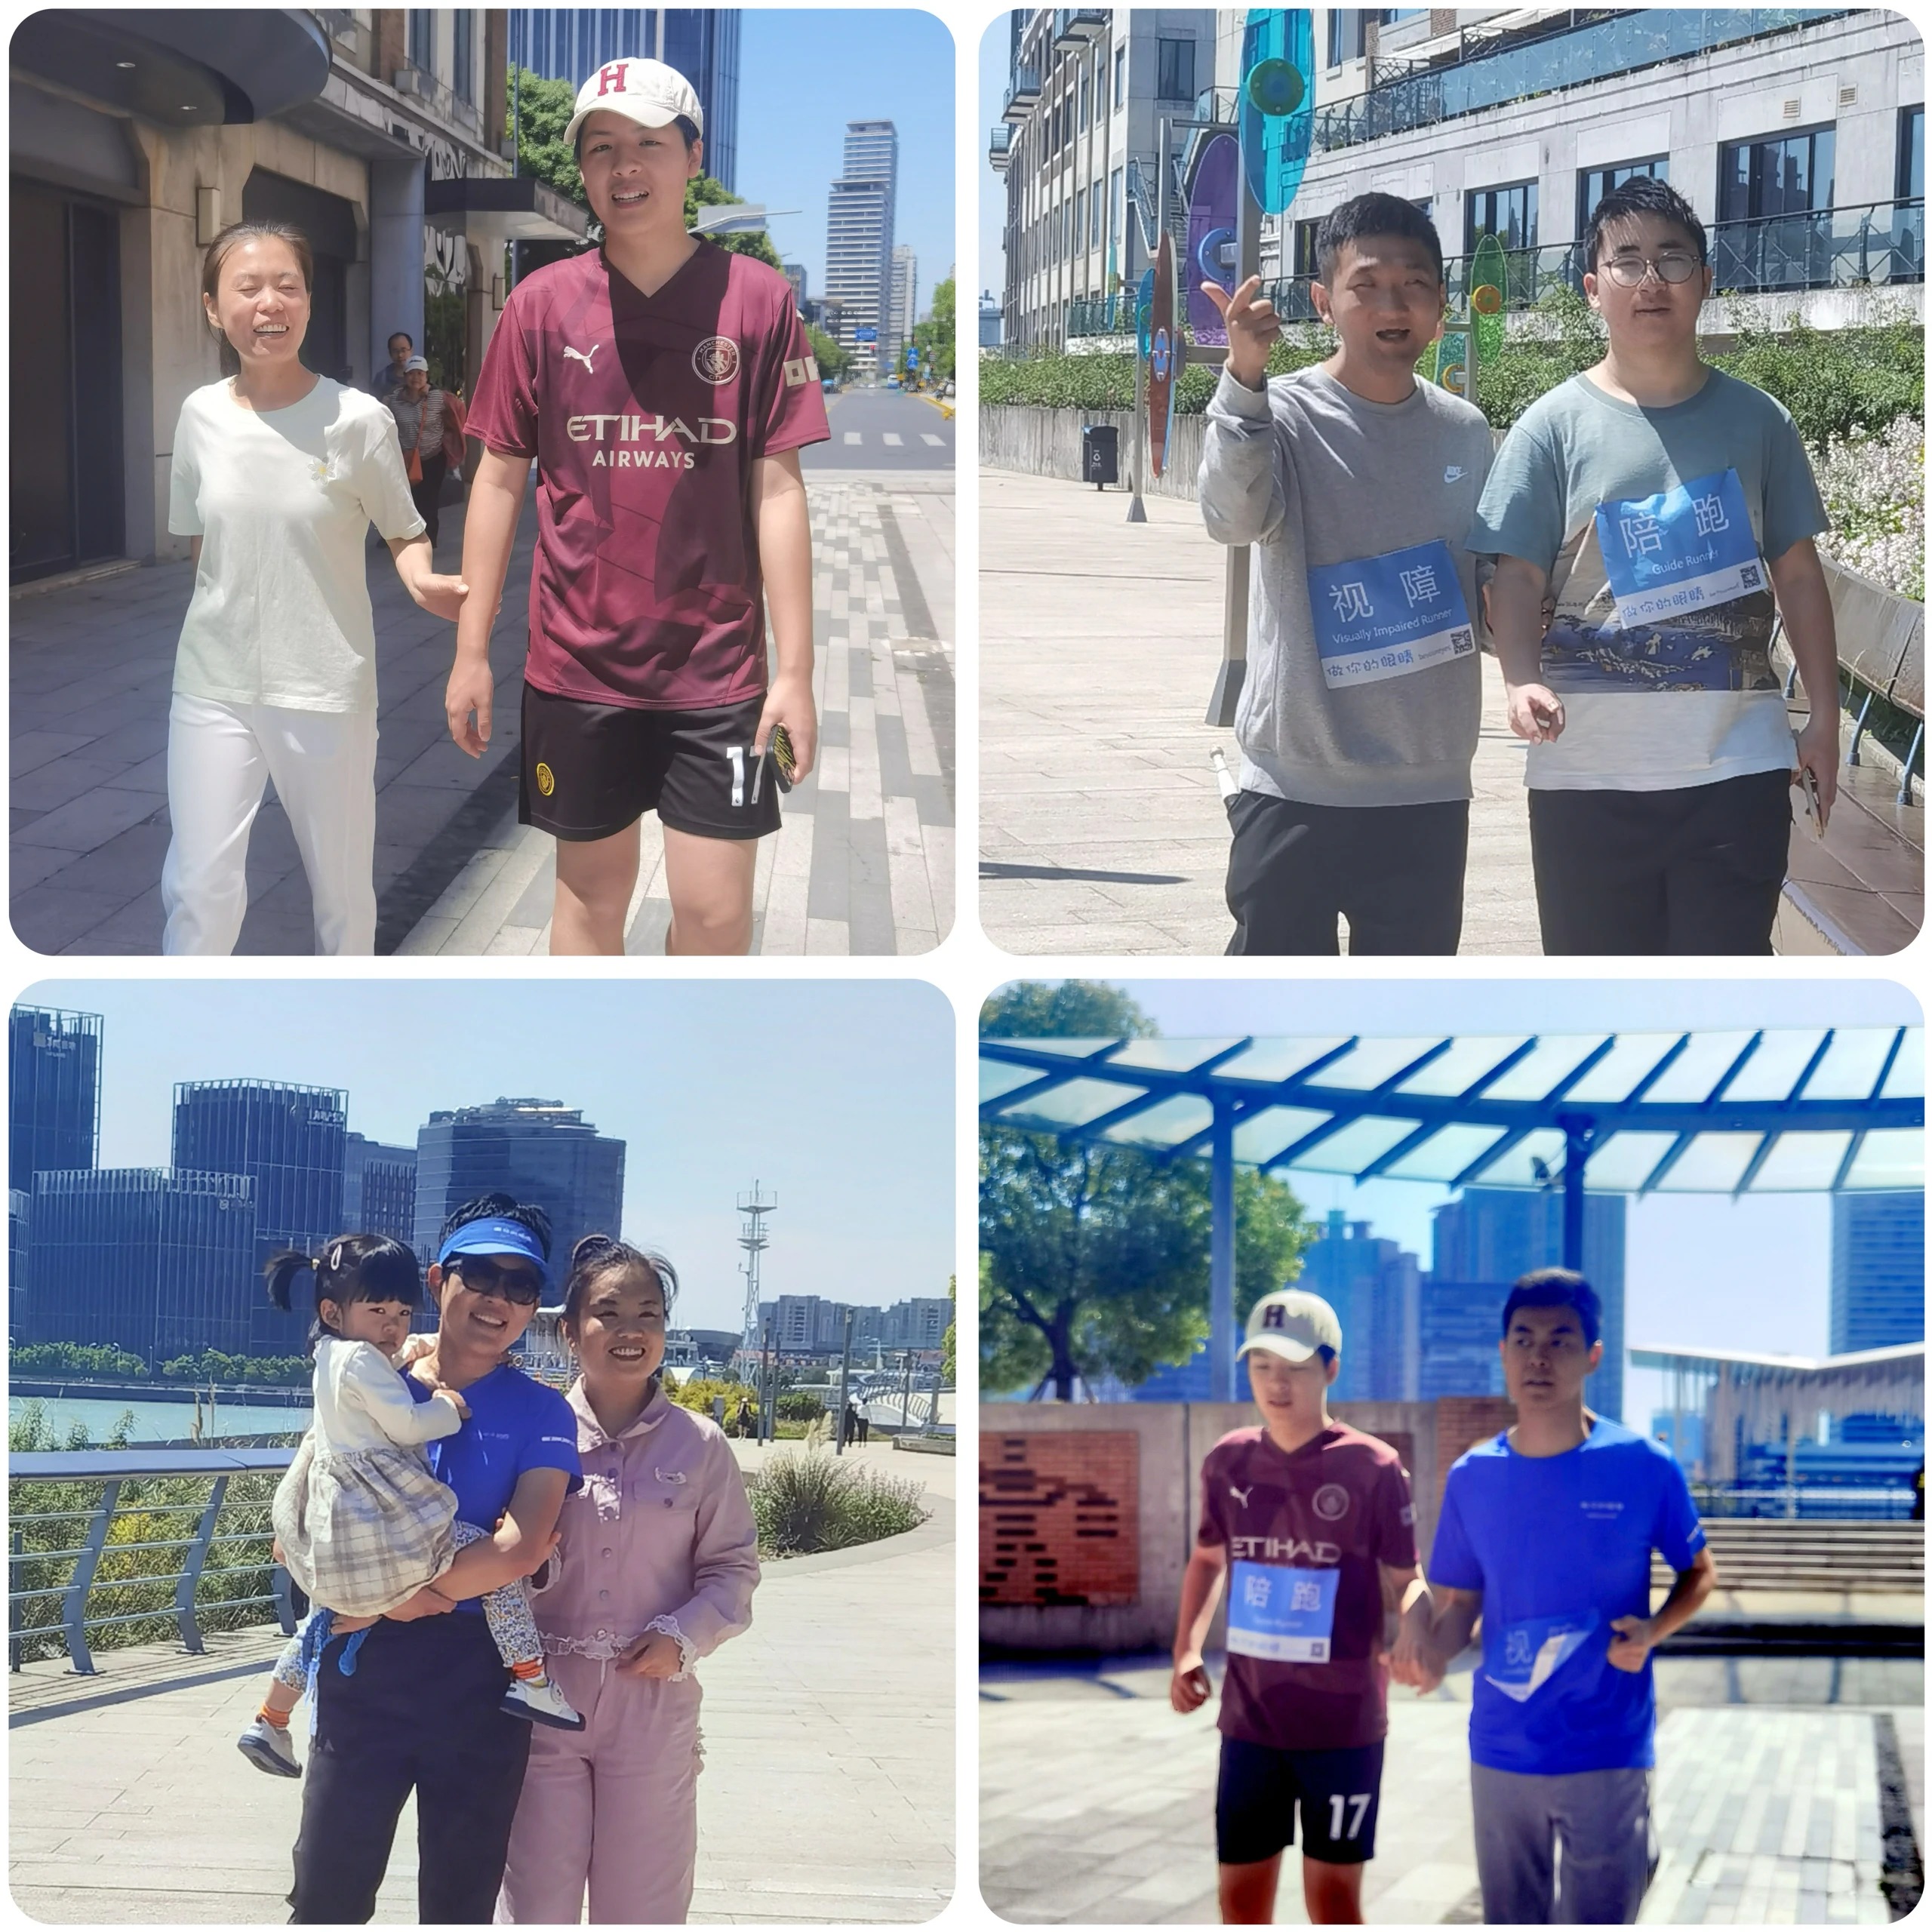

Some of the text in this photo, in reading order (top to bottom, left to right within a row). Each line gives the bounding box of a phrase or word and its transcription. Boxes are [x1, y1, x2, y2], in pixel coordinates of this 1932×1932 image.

[597, 63, 629, 97] H
[699, 340, 736, 357] MANCHESTER
[567, 414, 737, 445] ETIHAD
[592, 450, 695, 469] AIRWAYS
[1619, 494, 1729, 558] 陪跑
[1652, 559, 1684, 574] Guide
[1328, 565, 1441, 623] 视障
[1332, 608, 1452, 644] Visually Impaired Runner
[726, 746, 767, 807] 17
[1263, 1304, 1286, 1328] H
[1231, 1537, 1342, 1564] ETIHAD
[1244, 1575, 1321, 1612] 陪跑
[1328, 1792, 1372, 1841] 17
